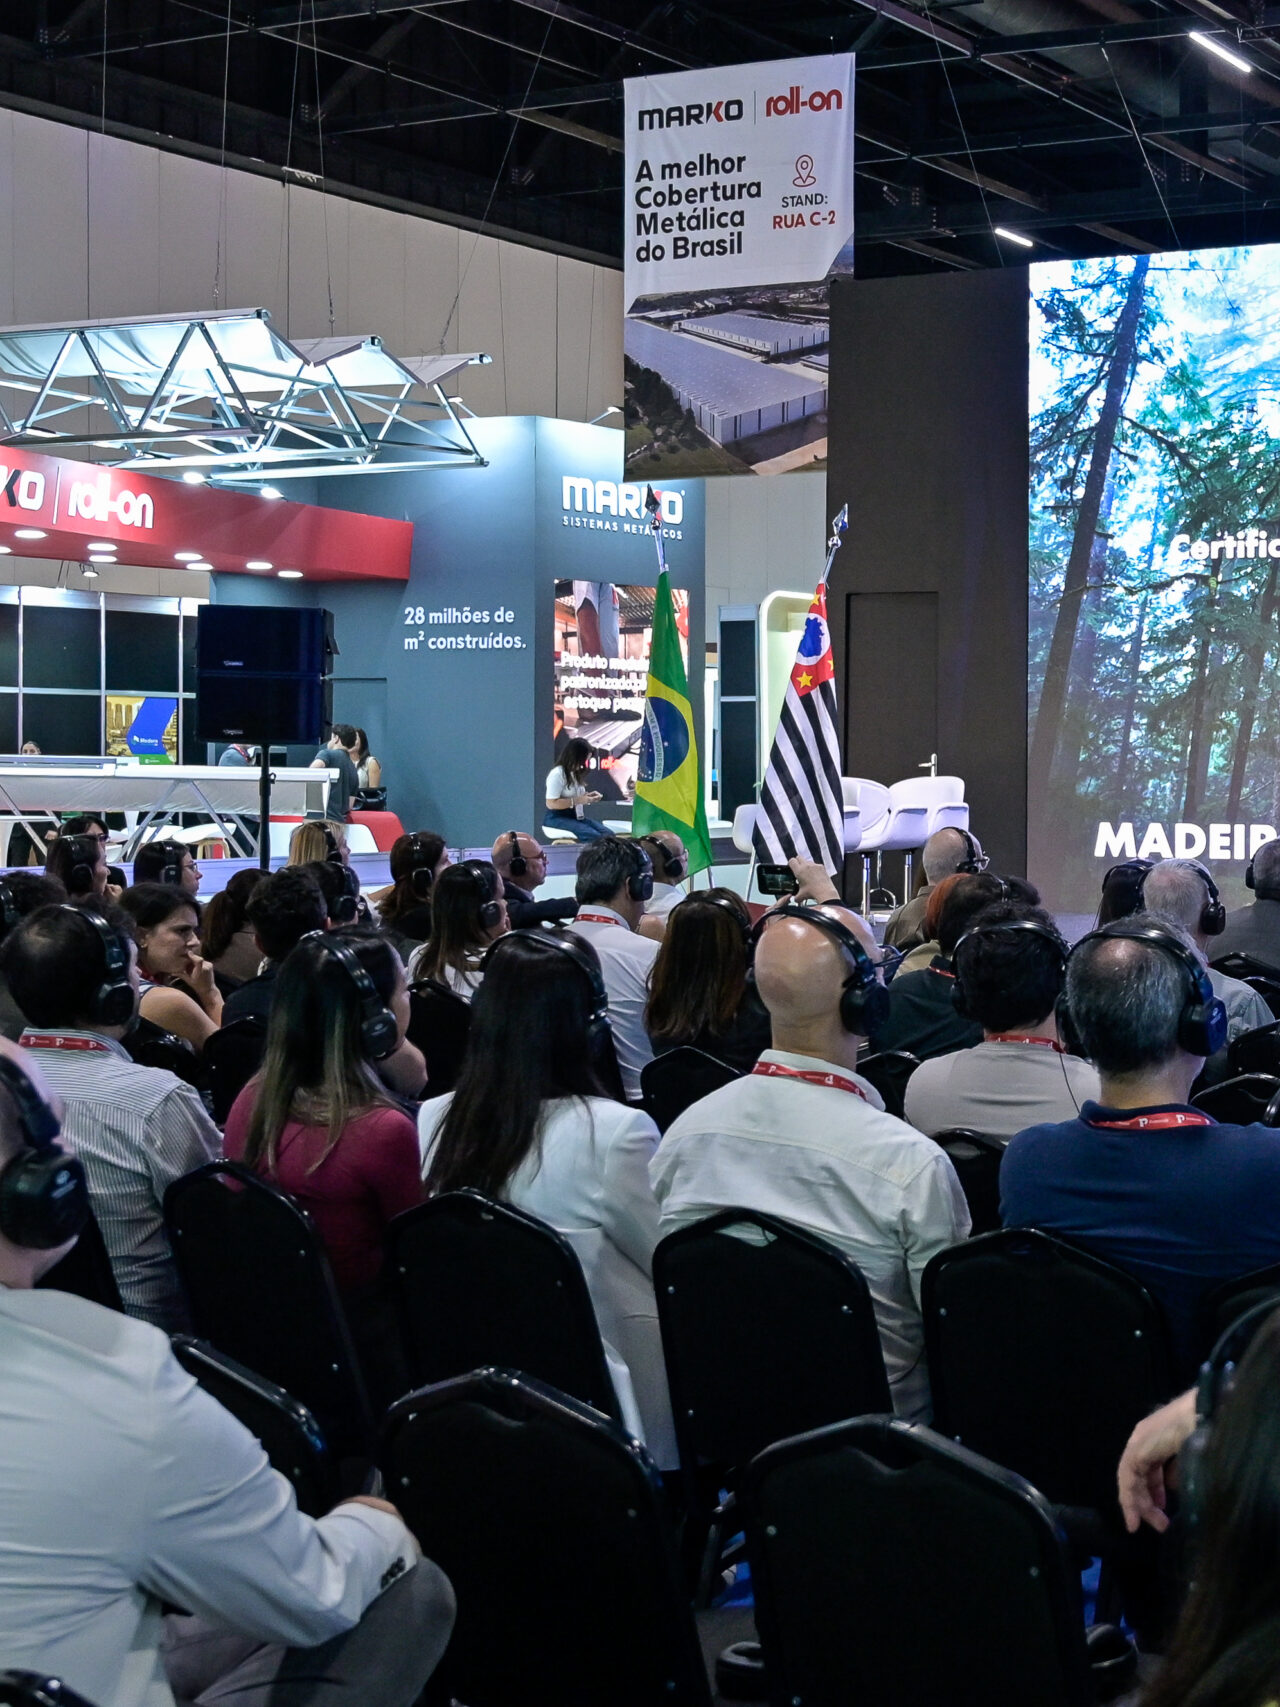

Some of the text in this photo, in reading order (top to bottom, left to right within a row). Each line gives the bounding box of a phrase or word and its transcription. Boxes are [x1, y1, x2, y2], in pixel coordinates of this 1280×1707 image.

[638, 86, 842, 131] MARKO roll-on
[635, 153, 746, 183] A melhor
[635, 181, 762, 209] Cobertura
[781, 193, 828, 208] STAND:
[636, 207, 745, 236] Metálica
[773, 210, 836, 230] RUA C-2
[636, 231, 743, 263] do Brasil
[68, 472, 154, 529] roll-on
[563, 516, 683, 540] SISTEMAS METÁLCOS
[404, 606, 515, 624] 28 milhões de
[404, 631, 527, 649] m² construídos.
